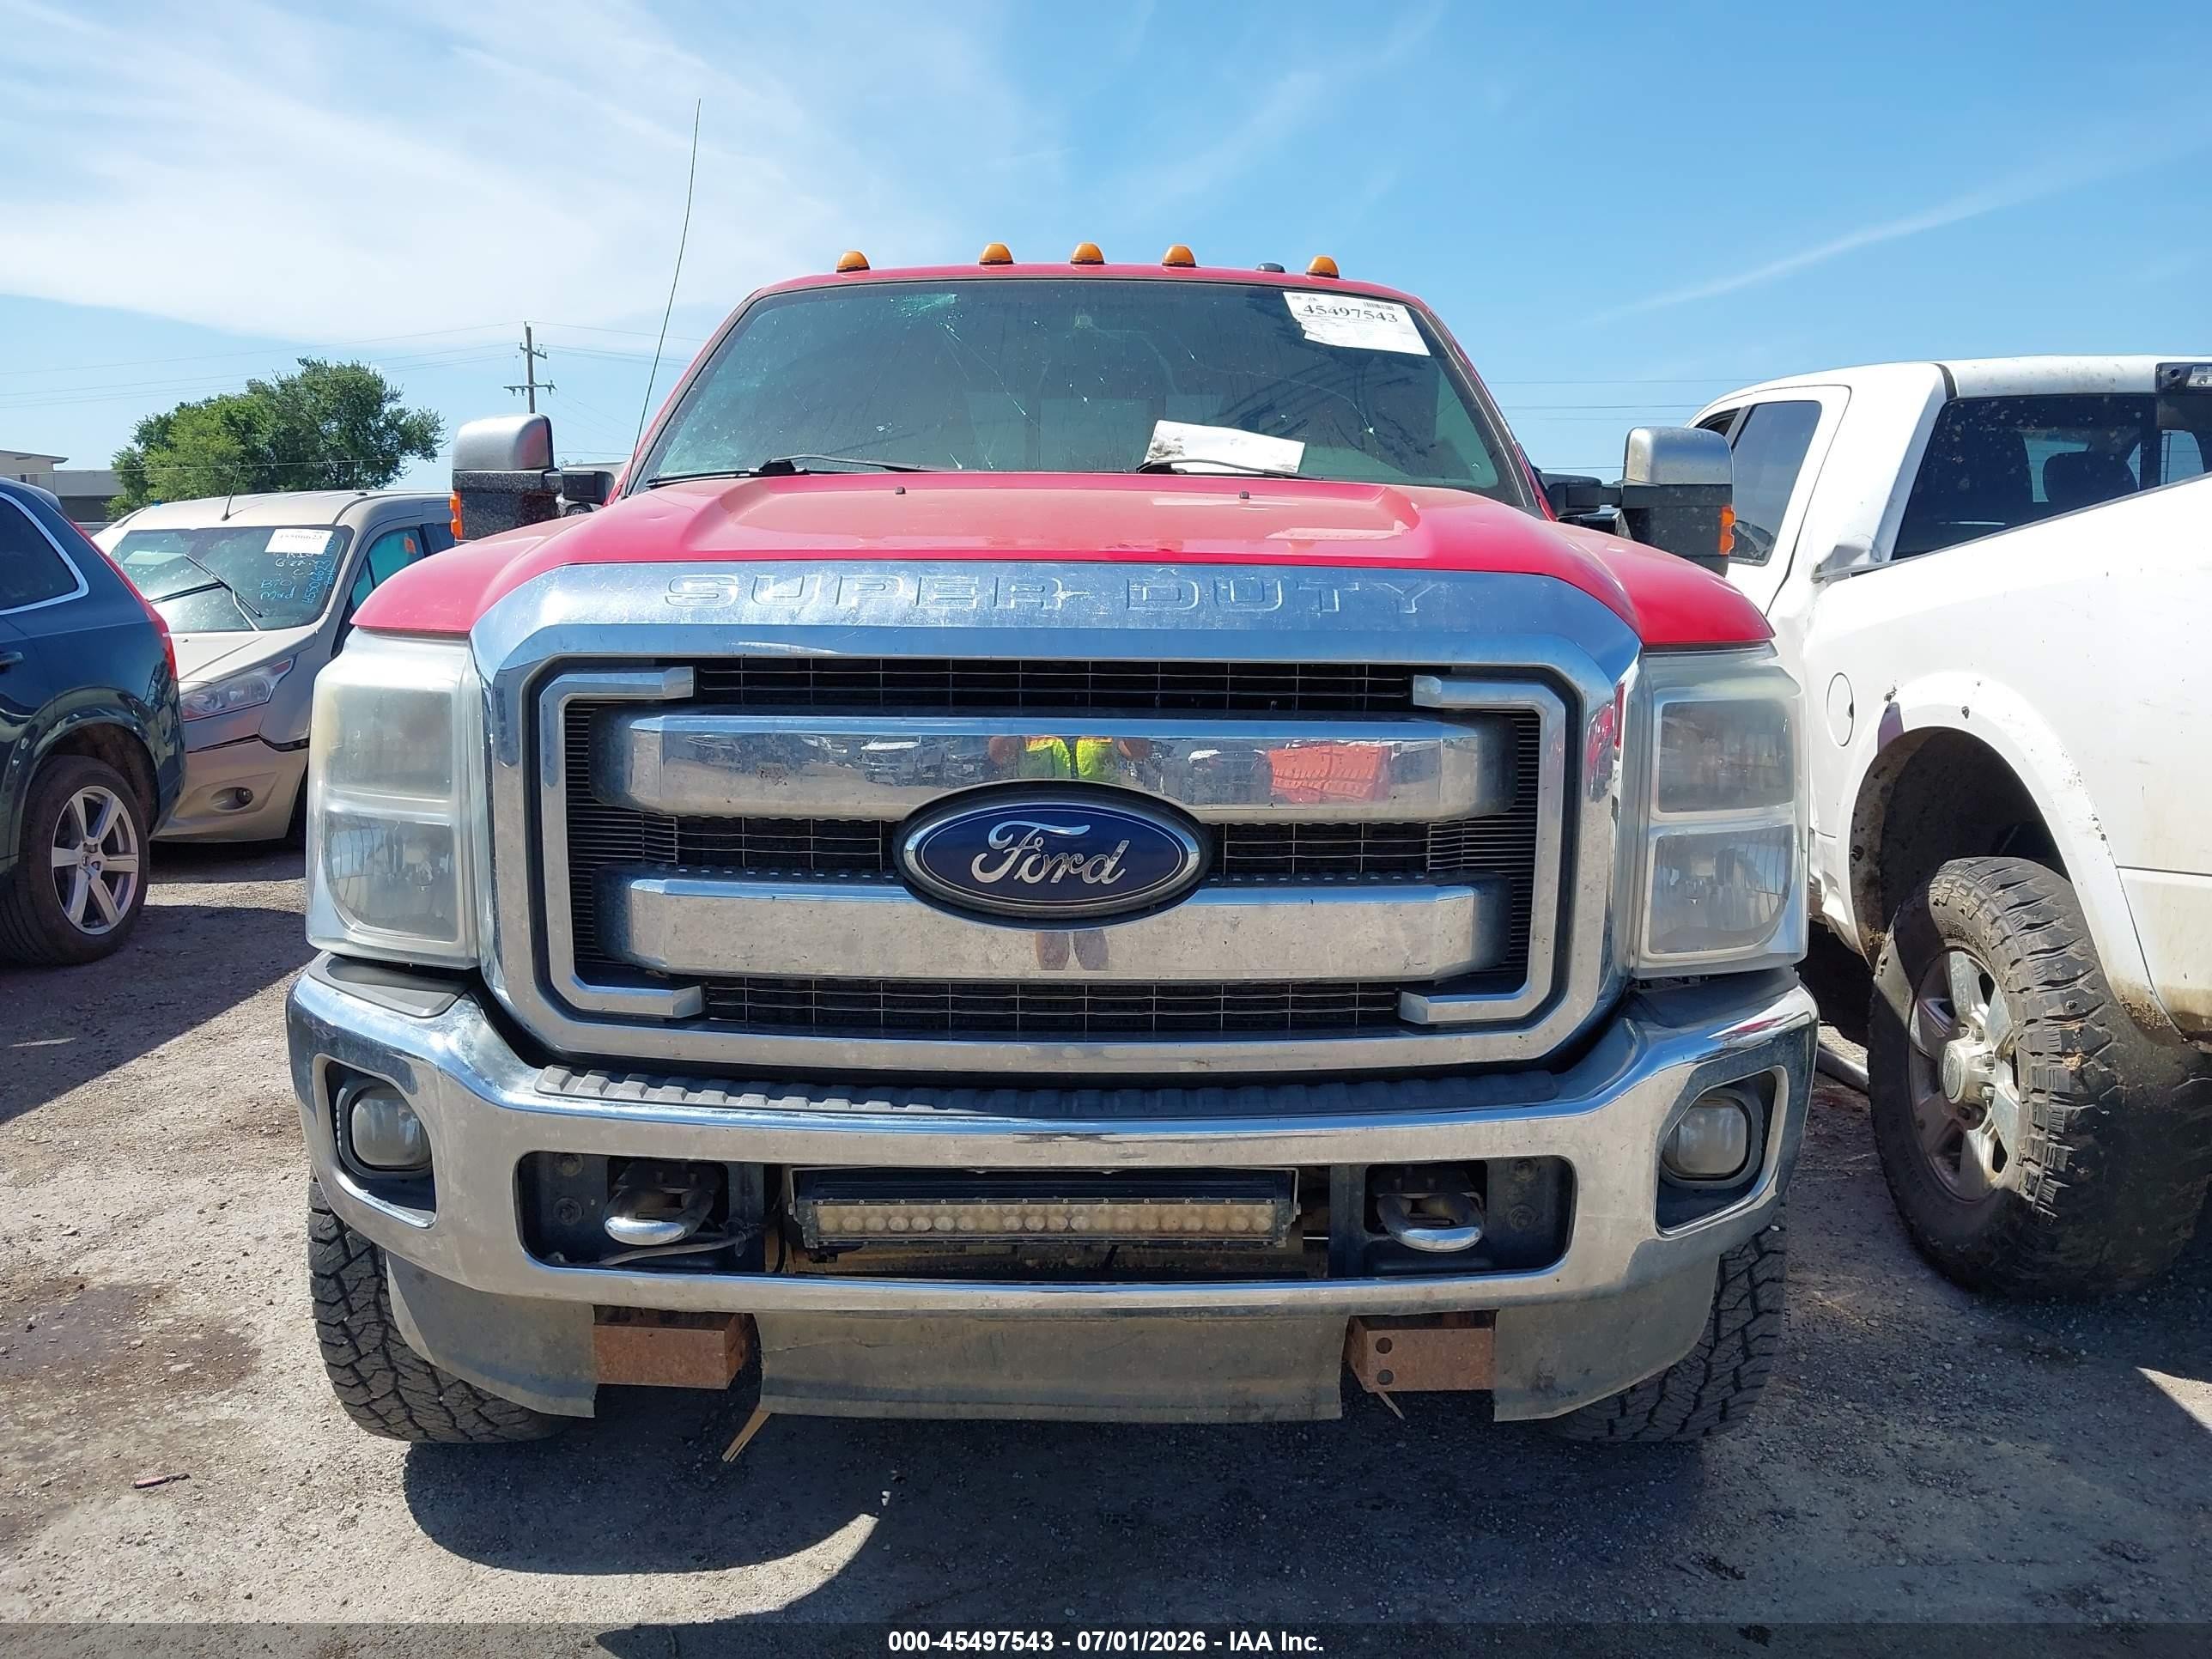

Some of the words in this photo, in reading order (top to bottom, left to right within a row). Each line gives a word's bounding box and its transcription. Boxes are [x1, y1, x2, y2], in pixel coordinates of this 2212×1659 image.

[1304, 304, 1398, 323] 45497543
[665, 574, 1062, 611] SUPER
[1126, 579, 1439, 614] DUTY
[971, 820, 1131, 885] Ford
